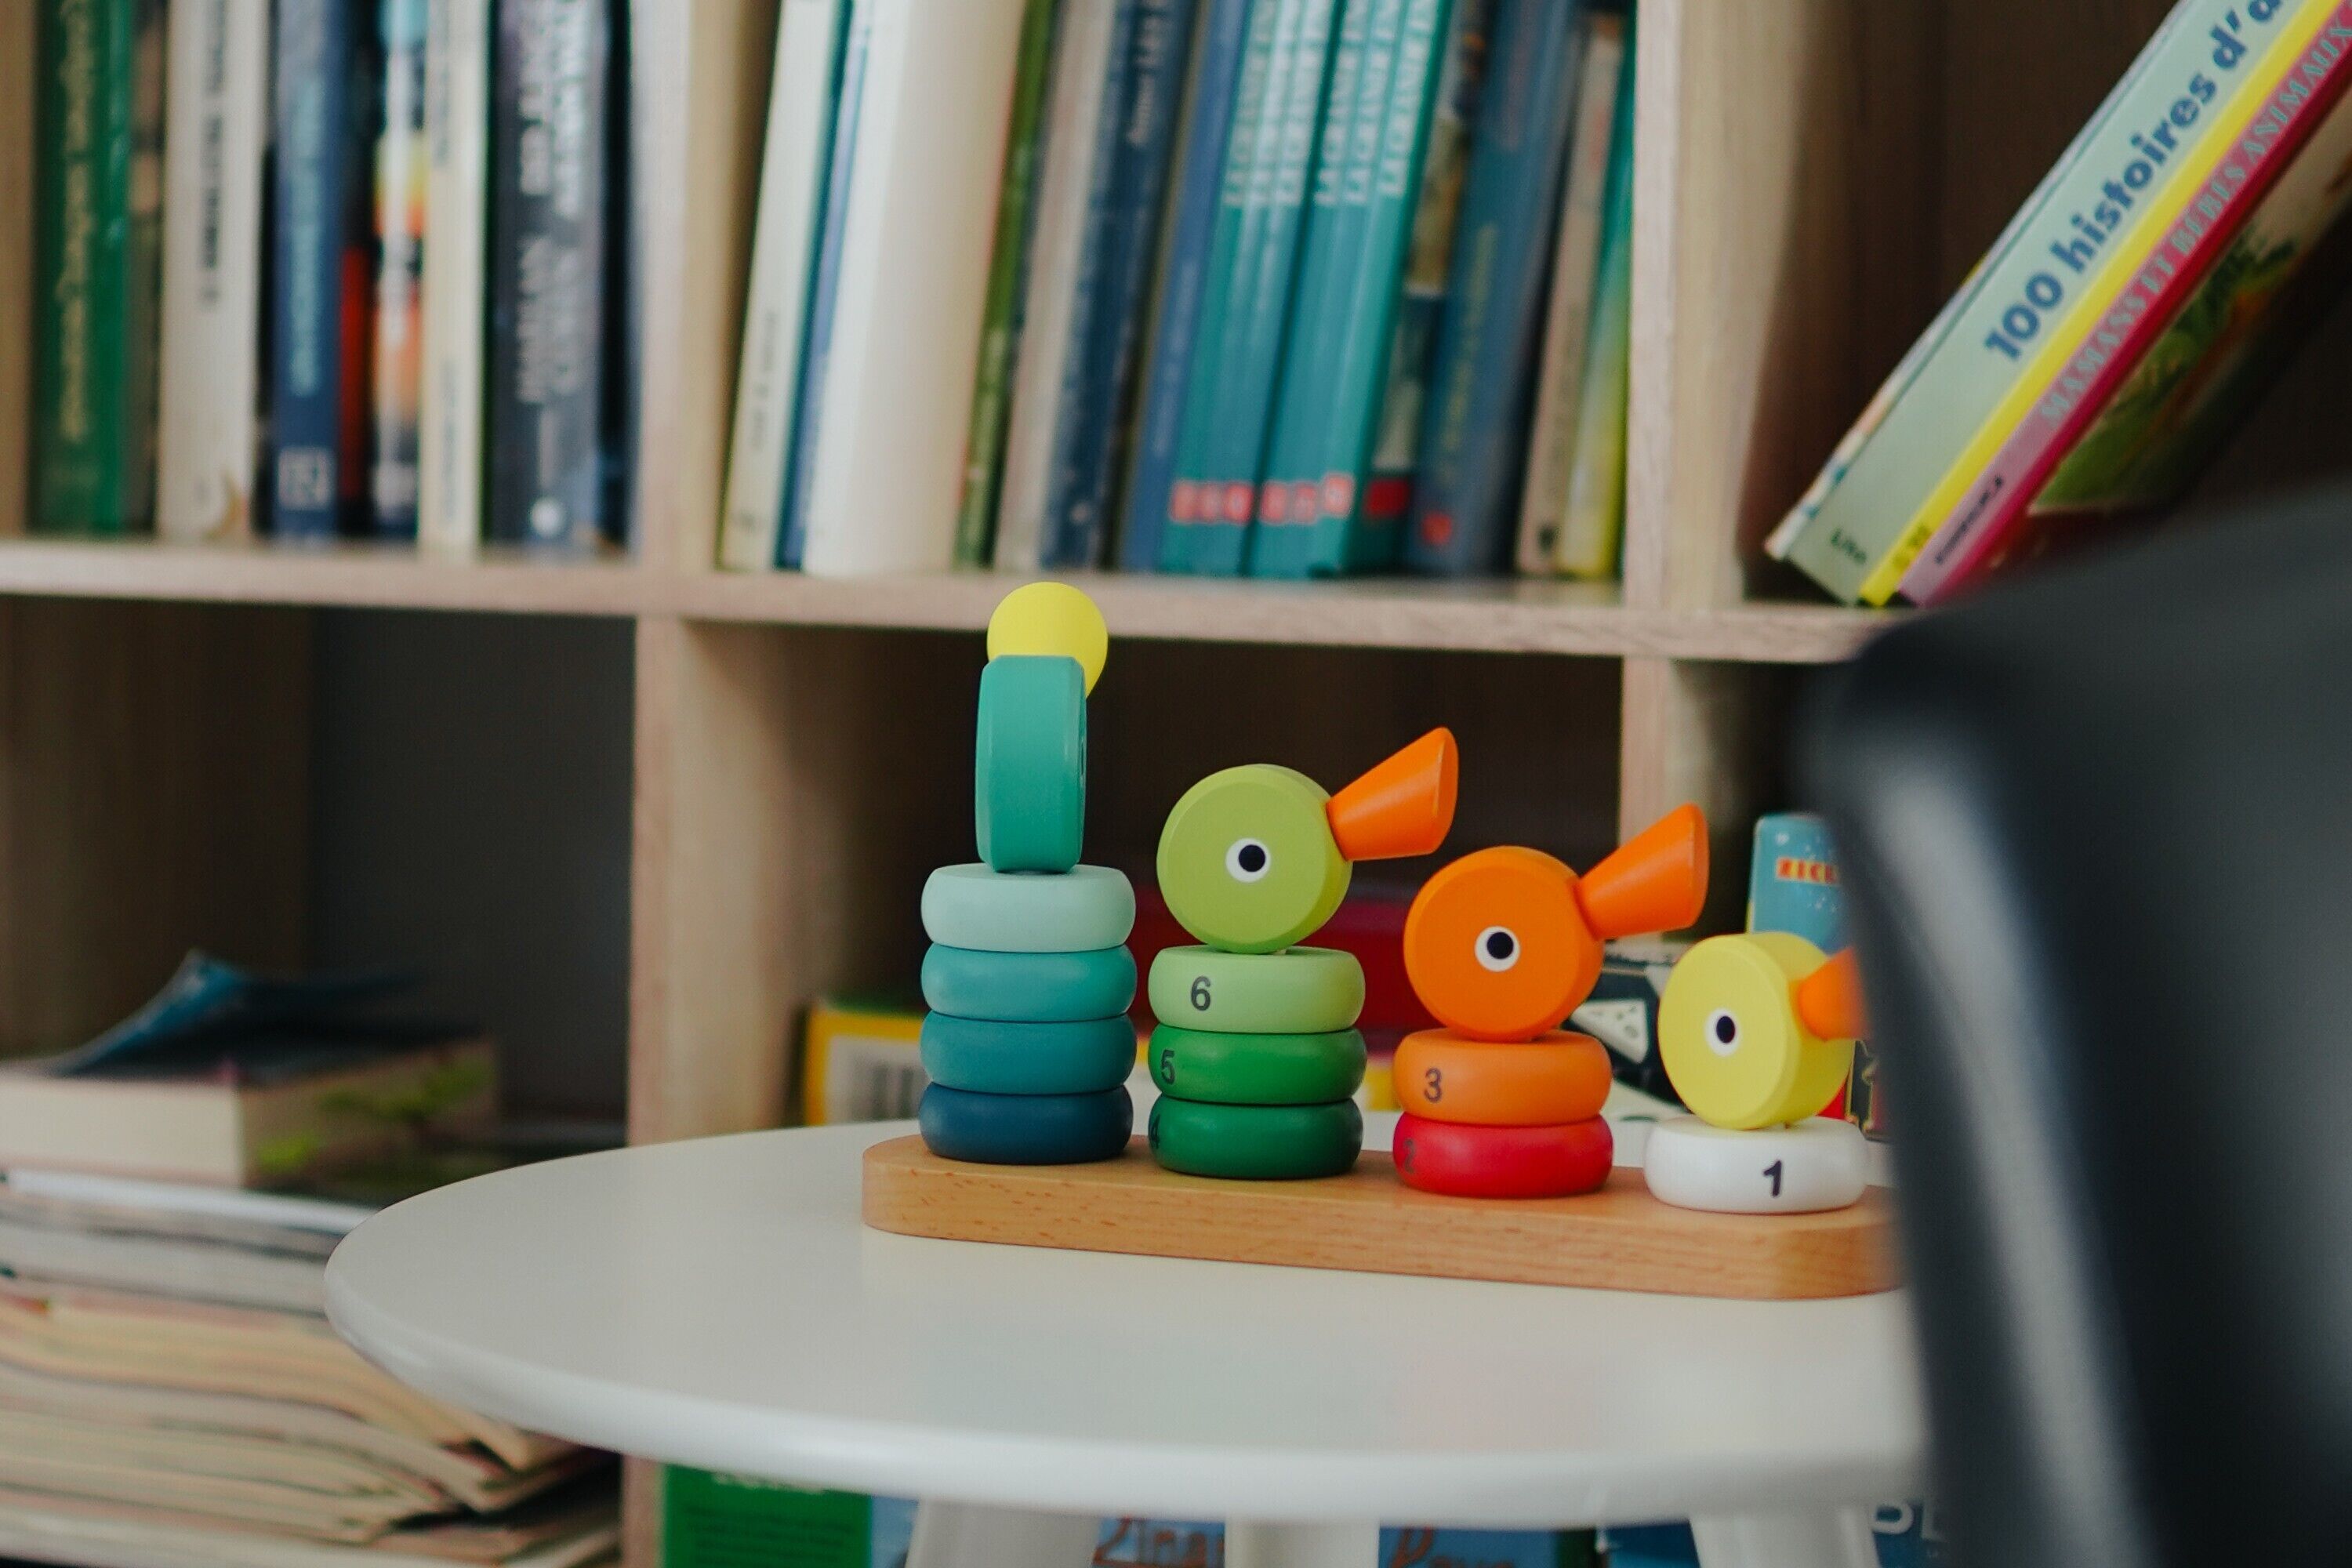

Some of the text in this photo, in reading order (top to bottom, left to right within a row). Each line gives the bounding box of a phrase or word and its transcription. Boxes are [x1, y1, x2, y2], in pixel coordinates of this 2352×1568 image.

[1983, 270, 2064, 361] 100
[2047, 74, 2218, 274] histoires
[1189, 975, 1213, 1011] 6
[1160, 1049, 1176, 1085] 5
[1423, 1067, 1443, 1104] 3
[1762, 1160, 1783, 1197] 1
